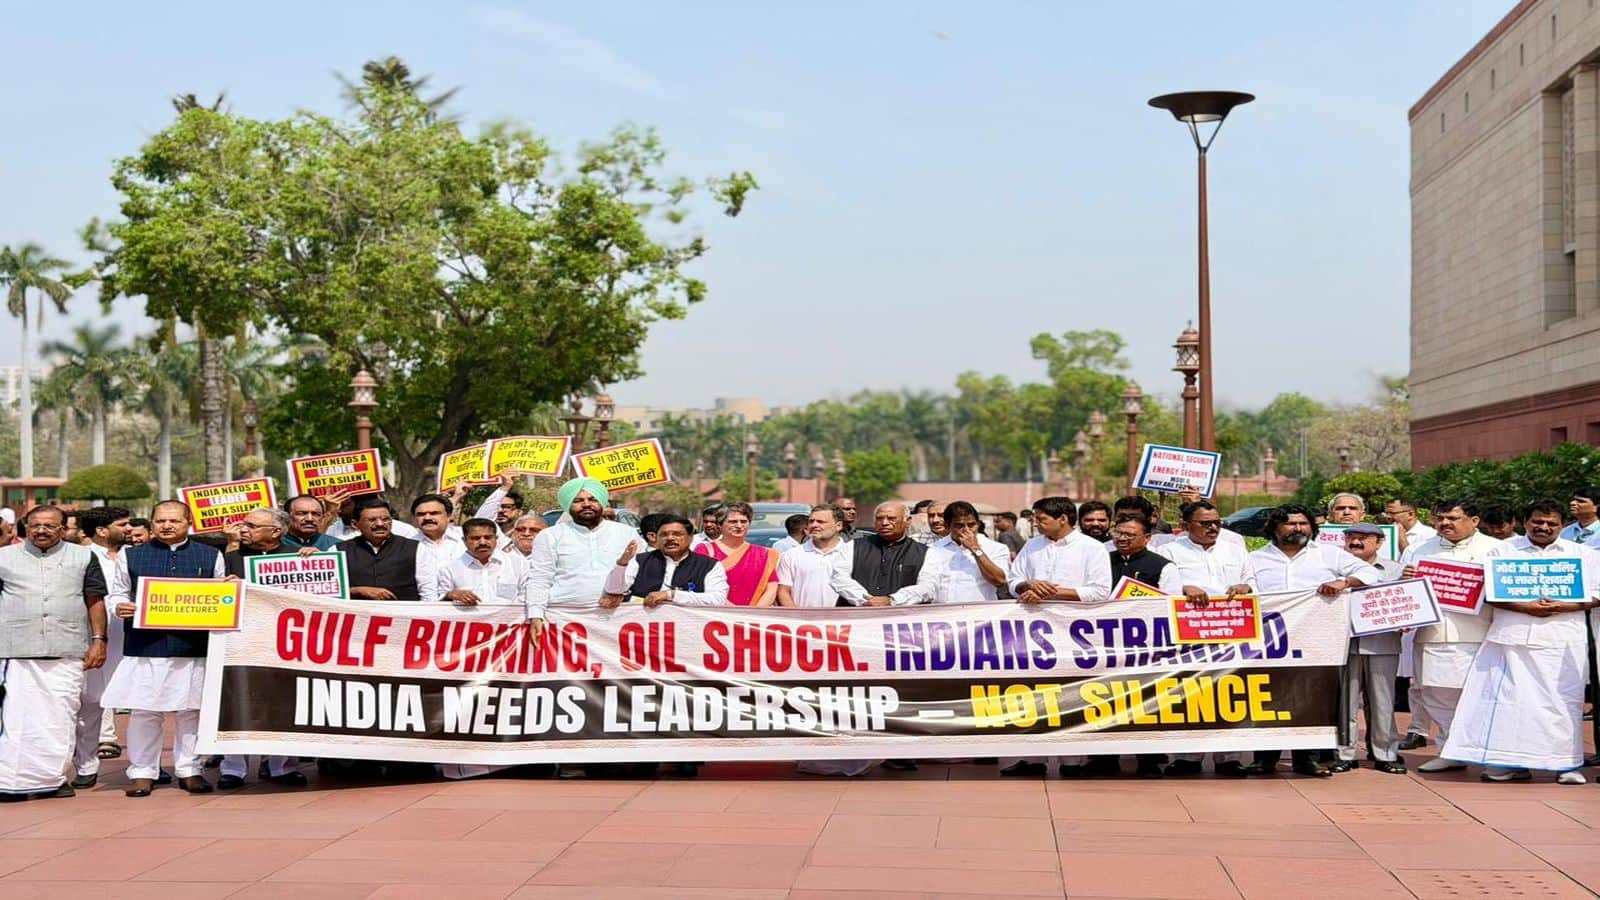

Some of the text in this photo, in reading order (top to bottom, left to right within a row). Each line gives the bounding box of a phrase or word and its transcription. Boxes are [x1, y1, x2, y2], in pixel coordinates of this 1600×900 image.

[301, 459, 328, 469] INDIA
[329, 456, 358, 465] NEEDS
[586, 455, 604, 466] देश
[605, 451, 621, 462] को
[1152, 451, 1213, 464] NATIONAL SECURITY
[317, 464, 355, 476] LEADER
[636, 467, 656, 480] नहीं
[1152, 465, 1208, 478] ENERGY SECURITY
[308, 478, 327, 487] NOT
[336, 473, 367, 484] SILENT
[192, 488, 220, 498] INDIA
[221, 485, 252, 495] NEEDS
[210, 493, 248, 506] LEADER
[200, 508, 219, 518] NOT
[258, 558, 335, 574] INDIA NEED
[1495, 561, 1516, 573] मोदी
[1518, 562, 1529, 573] जी
[259, 571, 335, 585] LEADERSHIP
[150, 593, 219, 605] OIL PRICES
[150, 605, 173, 613] MODI
[276, 608, 393, 667] GULF
[403, 618, 602, 678] BURNING,
[618, 621, 687, 672] OIL
[702, 620, 869, 672] SHOCK.
[882, 619, 1057, 672] INDIANS
[294, 677, 426, 732] INDIA
[443, 686, 586, 735] NEEDS
[603, 685, 899, 732] LEADERSHIP
[969, 684, 1061, 728] NOT
[1079, 674, 1292, 729] SILENCE.
